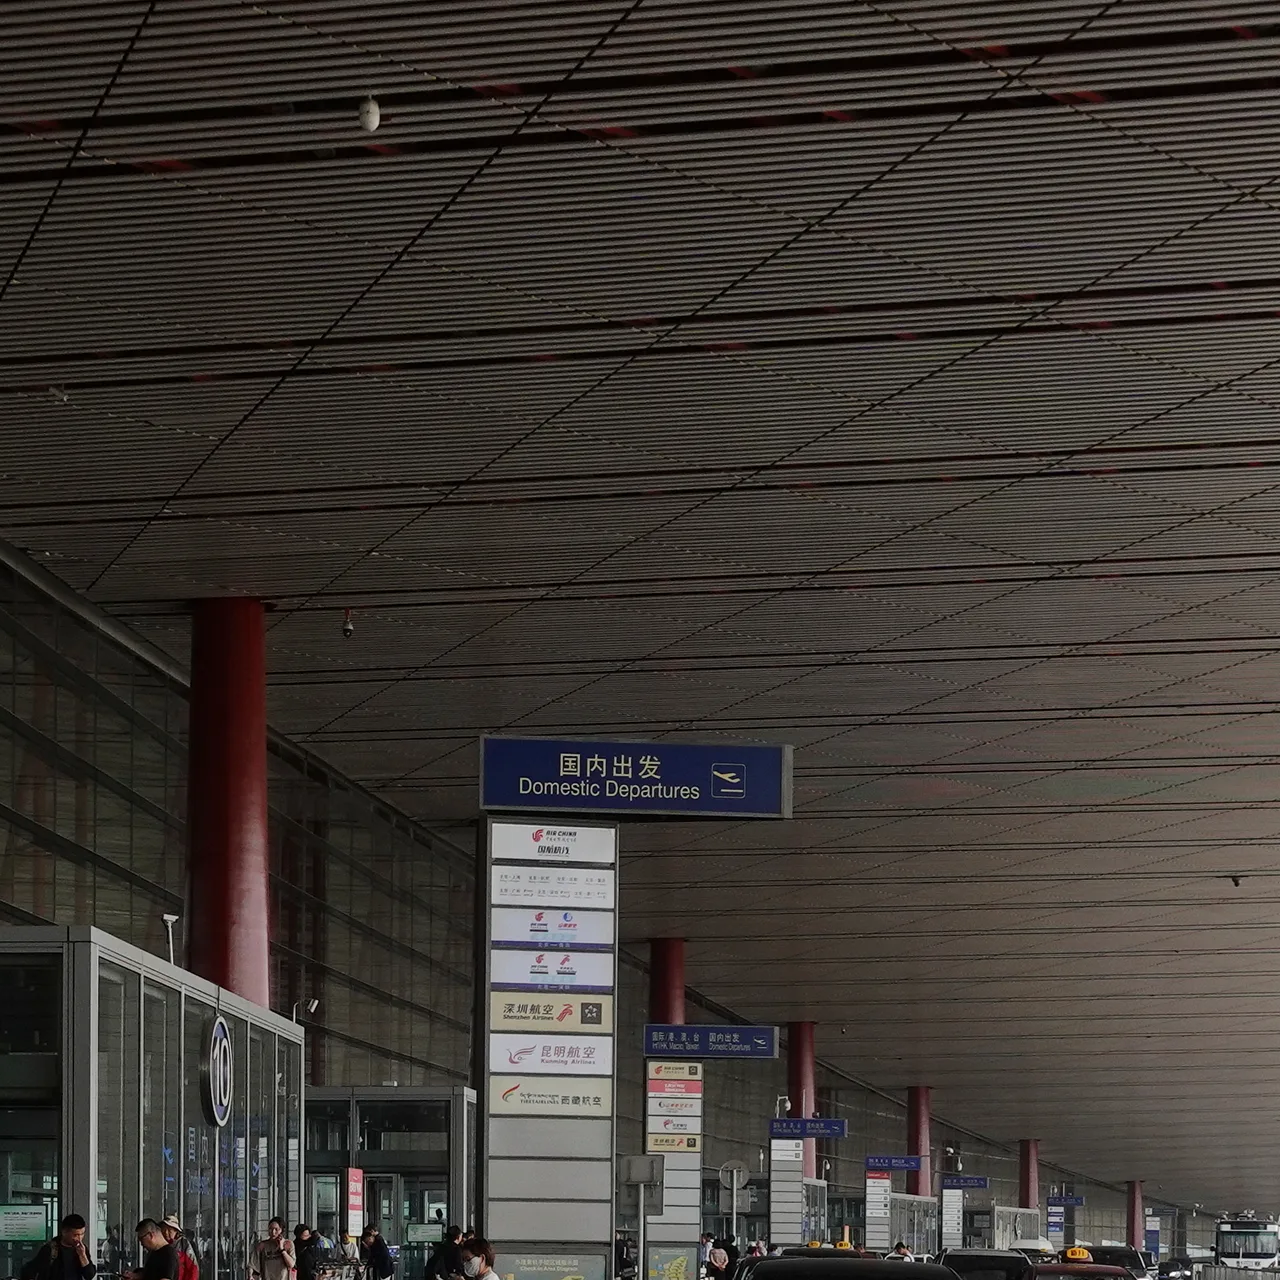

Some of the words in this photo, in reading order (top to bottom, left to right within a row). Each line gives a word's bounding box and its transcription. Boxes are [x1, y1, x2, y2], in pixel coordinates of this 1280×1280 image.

[559, 753, 662, 779] 国内出发
[519, 777, 600, 797] Domestic
[606, 780, 700, 801] Departures
[503, 1003, 554, 1015] 深圳航空
[709, 1032, 740, 1043] 国内出发
[541, 1045, 596, 1059] 昆明航空
[213, 1036, 231, 1107] 10
[561, 1095, 602, 1107] 西藏航空
